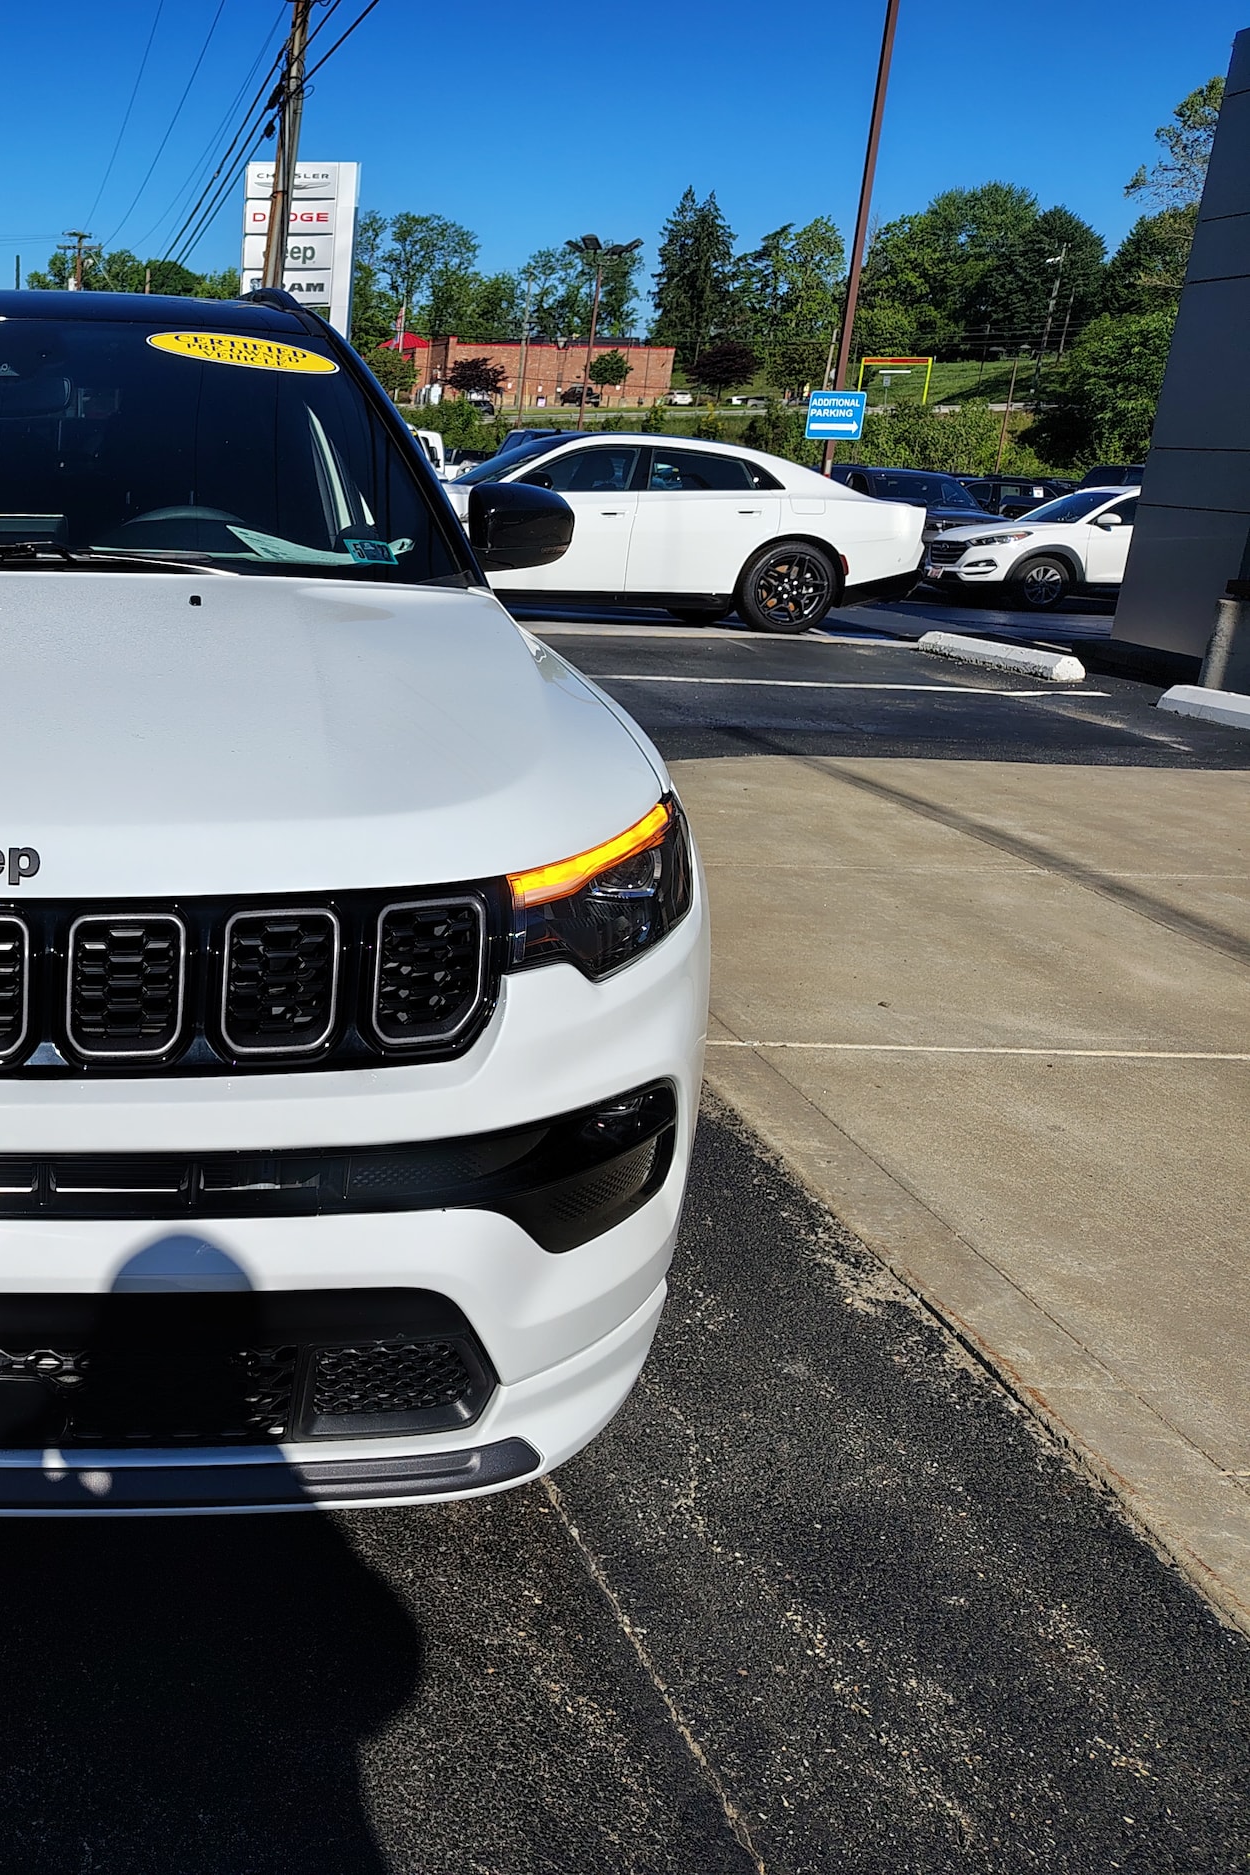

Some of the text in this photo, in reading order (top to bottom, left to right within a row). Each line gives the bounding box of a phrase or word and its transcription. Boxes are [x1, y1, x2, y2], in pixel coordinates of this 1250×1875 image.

[252, 212, 329, 223] DDGE
[281, 282, 325, 293] AM
[174, 335, 307, 359] CERTIFIED
[187, 343, 300, 364] PRE-OWNED
[203, 350, 288, 368] VEHICLE
[811, 397, 861, 408] ADDITIONAL
[810, 408, 853, 418] PARKING
